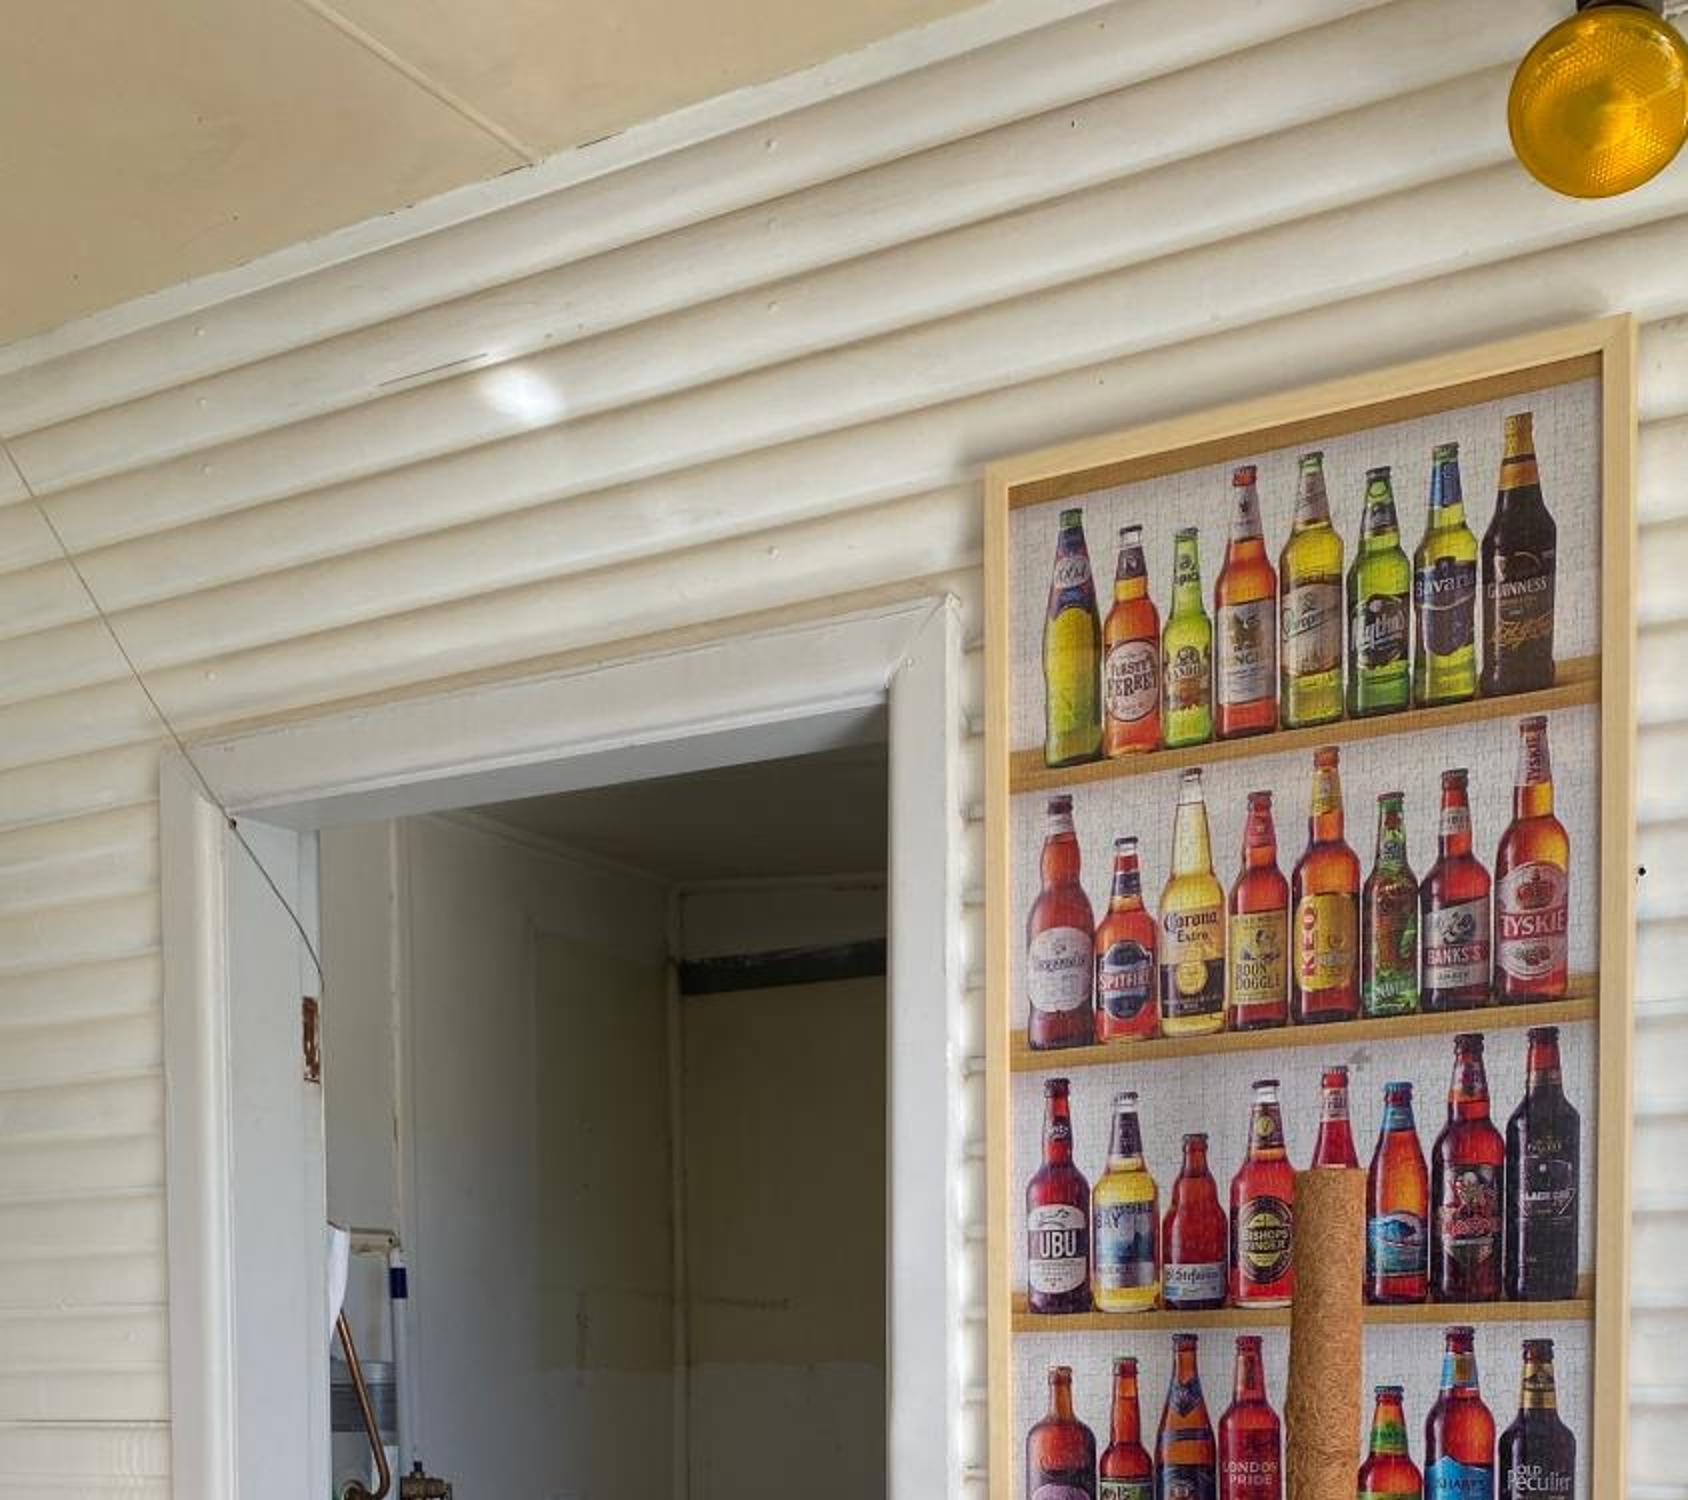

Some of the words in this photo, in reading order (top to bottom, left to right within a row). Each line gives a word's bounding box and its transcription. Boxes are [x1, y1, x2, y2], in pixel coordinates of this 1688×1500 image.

[1487, 575, 1548, 599] GUINNESS
[1163, 910, 1218, 935] Corona
[1501, 909, 1566, 938] TYSKIE
[1040, 1230, 1077, 1259] UBU
[1221, 1460, 1279, 1473] LONDON
[1516, 1463, 1543, 1475] OLD
[1229, 1473, 1273, 1486] PRIDE
